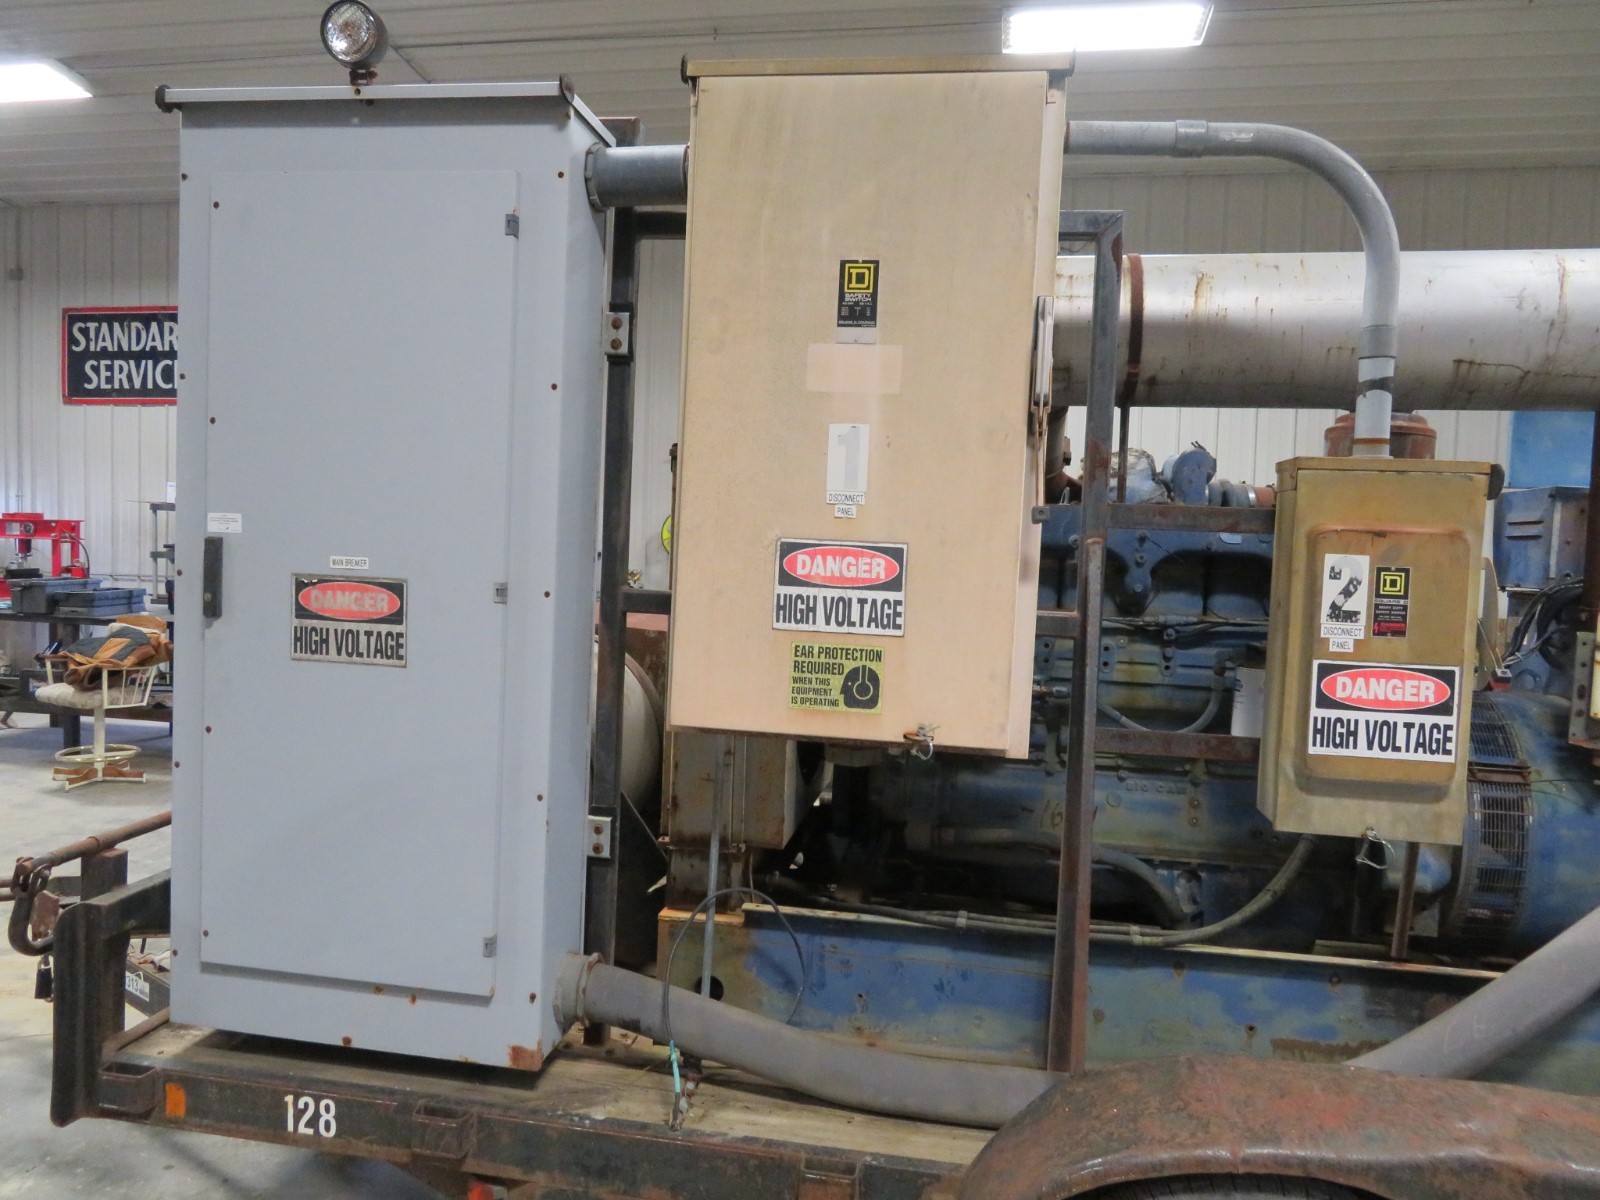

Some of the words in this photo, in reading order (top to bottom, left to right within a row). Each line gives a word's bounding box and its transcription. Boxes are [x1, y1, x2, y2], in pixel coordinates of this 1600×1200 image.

[71, 321, 178, 352] STANDAR
[83, 359, 178, 389] SERVIC
[828, 493, 864, 503] DISCONNECT
[836, 507, 854, 516] PANEL
[331, 558, 344, 566] MAIN
[344, 558, 368, 567] BREAKER
[796, 554, 886, 580] DANGER
[1325, 556, 1363, 623] 2
[310, 589, 388, 612] DANGER
[775, 593, 818, 625] HIGH
[822, 595, 903, 630] VOLTAGE
[1323, 626, 1362, 637] DISCONNECT
[293, 625, 330, 655] HIGH
[334, 628, 405, 661] VOLTAGE
[794, 644, 814, 658] EAR
[817, 646, 883, 662] PROTECTION
[1331, 641, 1351, 650] PANEL
[793, 660, 845, 676] REQUIRED
[791, 686, 833, 696] EQUIPMENT
[792, 676, 813, 684] WHEN
[814, 678, 831, 686] THIS
[1335, 676, 1436, 703] DANGER
[790, 696, 798, 704] IS
[799, 697, 840, 708] OPERATING
[1311, 716, 1359, 750] HIGH
[1364, 719, 1454, 756] VOLTAGE
[284, 1094, 337, 1138] 128
